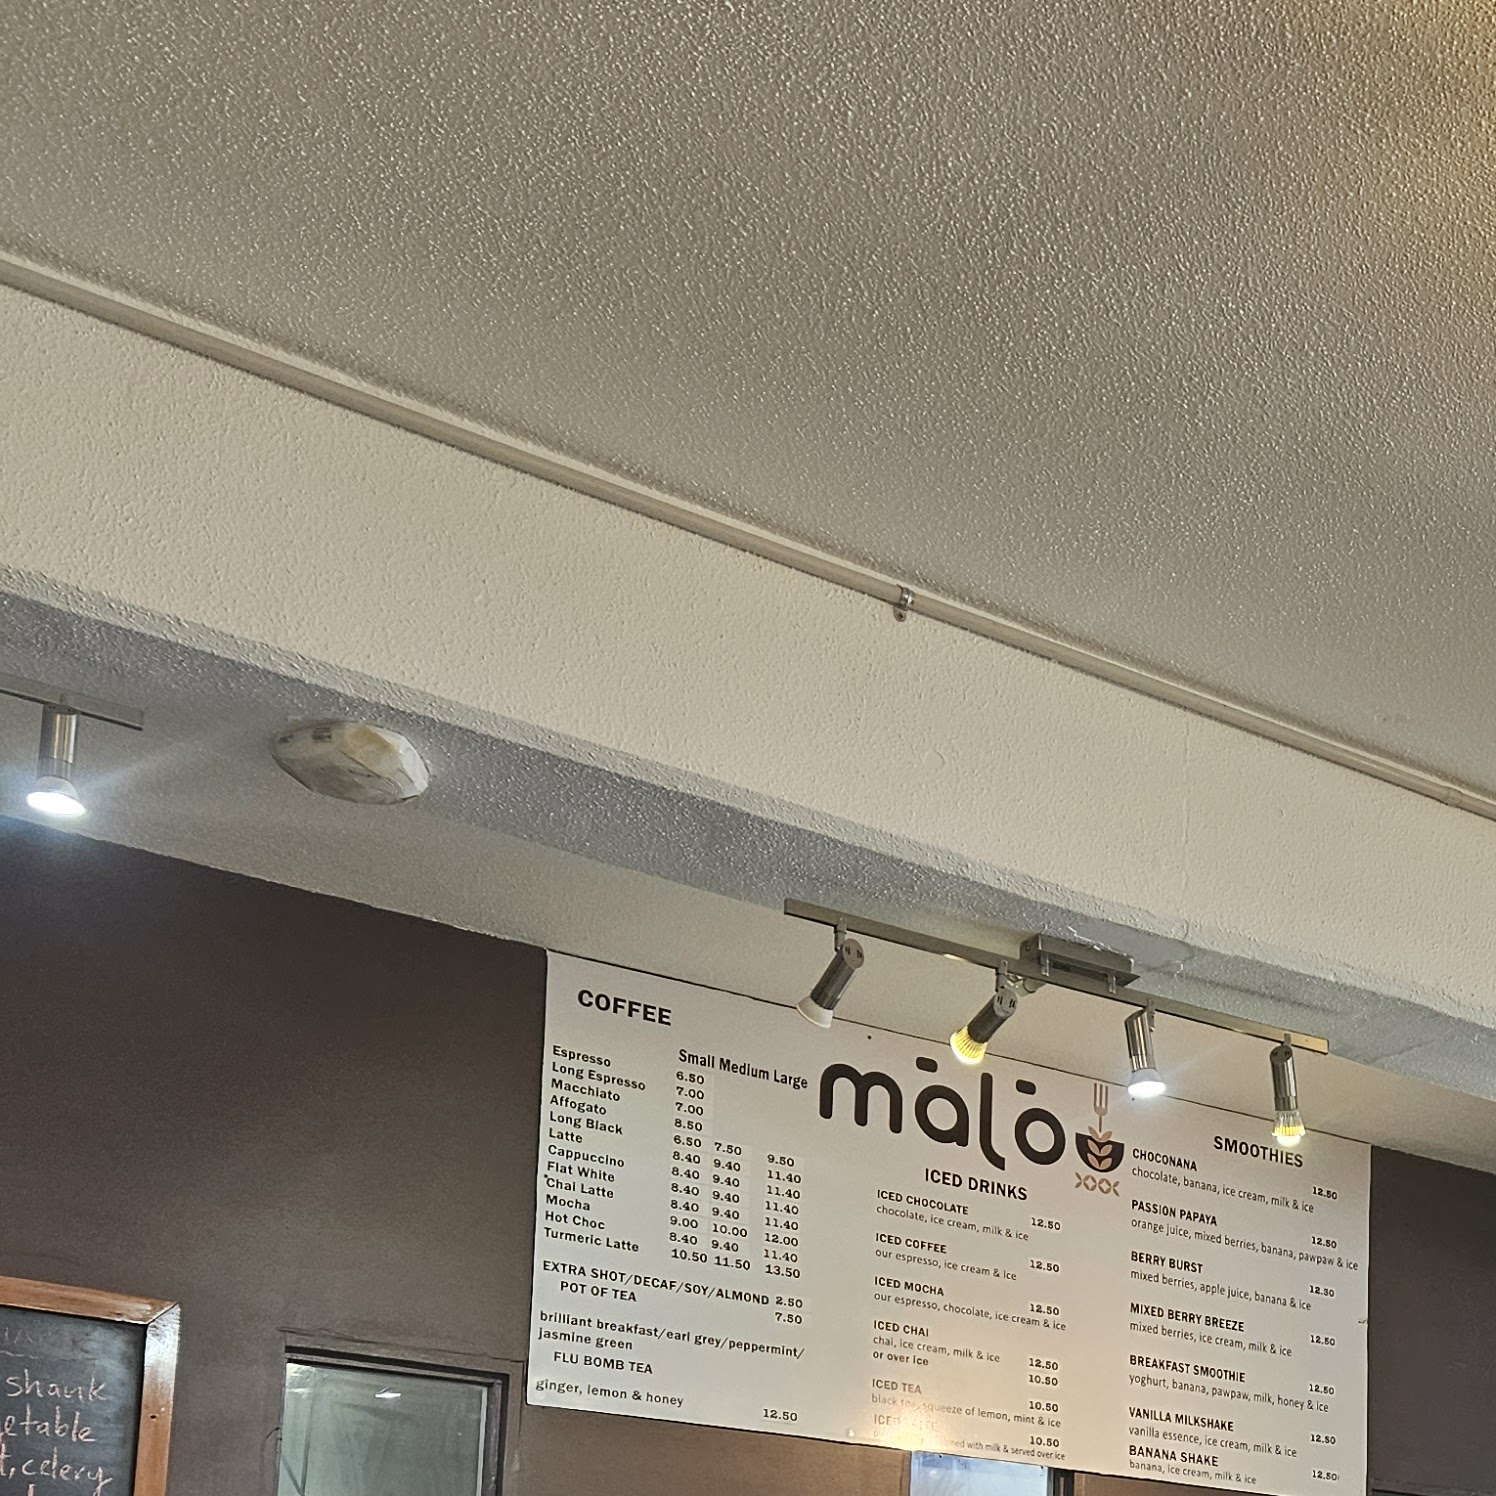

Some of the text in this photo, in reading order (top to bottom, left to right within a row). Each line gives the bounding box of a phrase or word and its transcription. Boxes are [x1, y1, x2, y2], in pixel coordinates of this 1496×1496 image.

[577, 989, 672, 1026] COFFEE
[552, 1044, 705, 1085] Espresso 6.50
[678, 1048, 808, 1090] Small Medium Large
[551, 1060, 705, 1103] Long Espresso 7.00
[550, 1077, 704, 1117] Macchiato 7.00
[549, 1094, 703, 1132] Affogato 8.50
[549, 1109, 795, 1167] Long Black 6.50 7.50 9.50
[1212, 1135, 1303, 1168] SMOOTHIES
[547, 1143, 624, 1168] Cappuccino
[548, 1126, 802, 1184] Latte 8.40 9.40 11.40
[1132, 1147, 1198, 1172] CHOCONANA
[546, 1158, 615, 1183] Flat White
[925, 1167, 1027, 1201] ICED DRINKS
[545, 1177, 614, 1199] Chai Latte
[545, 1193, 590, 1211] Mocha
[877, 1188, 969, 1215] ICED CHOCOLATE
[544, 1209, 605, 1232] Hot Choc
[1131, 1198, 1218, 1227] PASSION PAPAYA
[543, 1225, 639, 1252] Turmeric Latte
[875, 1232, 947, 1255] ICED COFFEE
[875, 1245, 1017, 1281] our espresso, ice cream & ice
[1130, 1250, 1203, 1274] BERRY BURST
[542, 1259, 803, 1309] EXTRA SHOT/DECAF/SOY/ALMOND 2.50
[874, 1275, 944, 1297] ICED MOCHA
[560, 1280, 802, 1325] POT OF TEA 7.50
[873, 1319, 929, 1338] ICED CHAI
[1129, 1301, 1245, 1333] MIXED BERRY BREEZE
[537, 1326, 633, 1350] jasmine green
[539, 1309, 805, 1360] brilliant breakfast/earl grey/peppermint/
[553, 1350, 653, 1375] FLU BOMB TEA
[1129, 1354, 1246, 1383] BREAKFAST SMOOTHIE
[534, 1378, 684, 1408] ginger, lemon & honey
[872, 1377, 922, 1395] ICED TEA
[762, 1408, 798, 1422] 12.50
[1128, 1406, 1234, 1432] VANILLA MILKSHAKE
[1128, 1444, 1219, 1467] BANANA SHAKE
